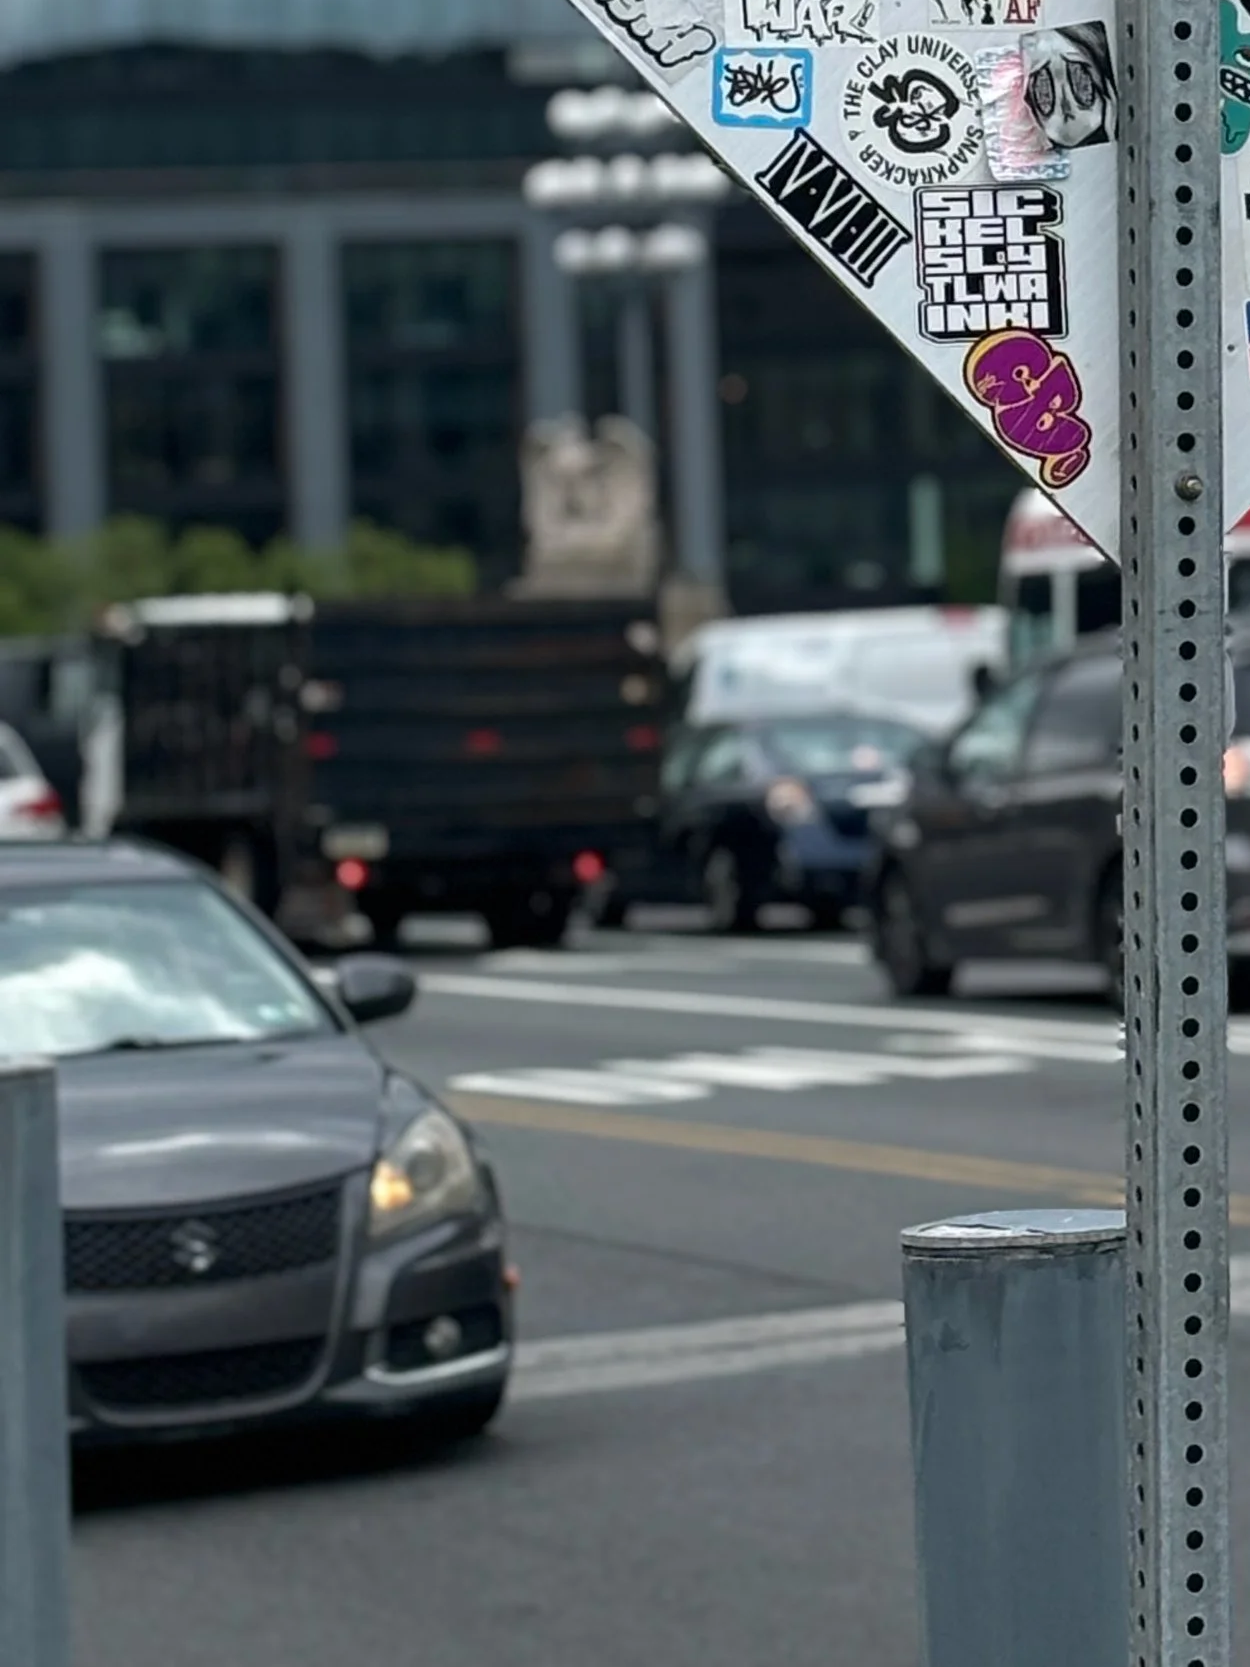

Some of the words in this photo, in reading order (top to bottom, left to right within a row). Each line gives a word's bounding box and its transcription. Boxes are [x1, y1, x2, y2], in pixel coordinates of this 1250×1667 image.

[844, 79, 865, 120] THE
[857, 38, 898, 79] CLAY
[908, 35, 980, 101] UNIVERSE
[859, 125, 984, 186] SNAPKRACKER
[922, 191, 1044, 217] SIC
